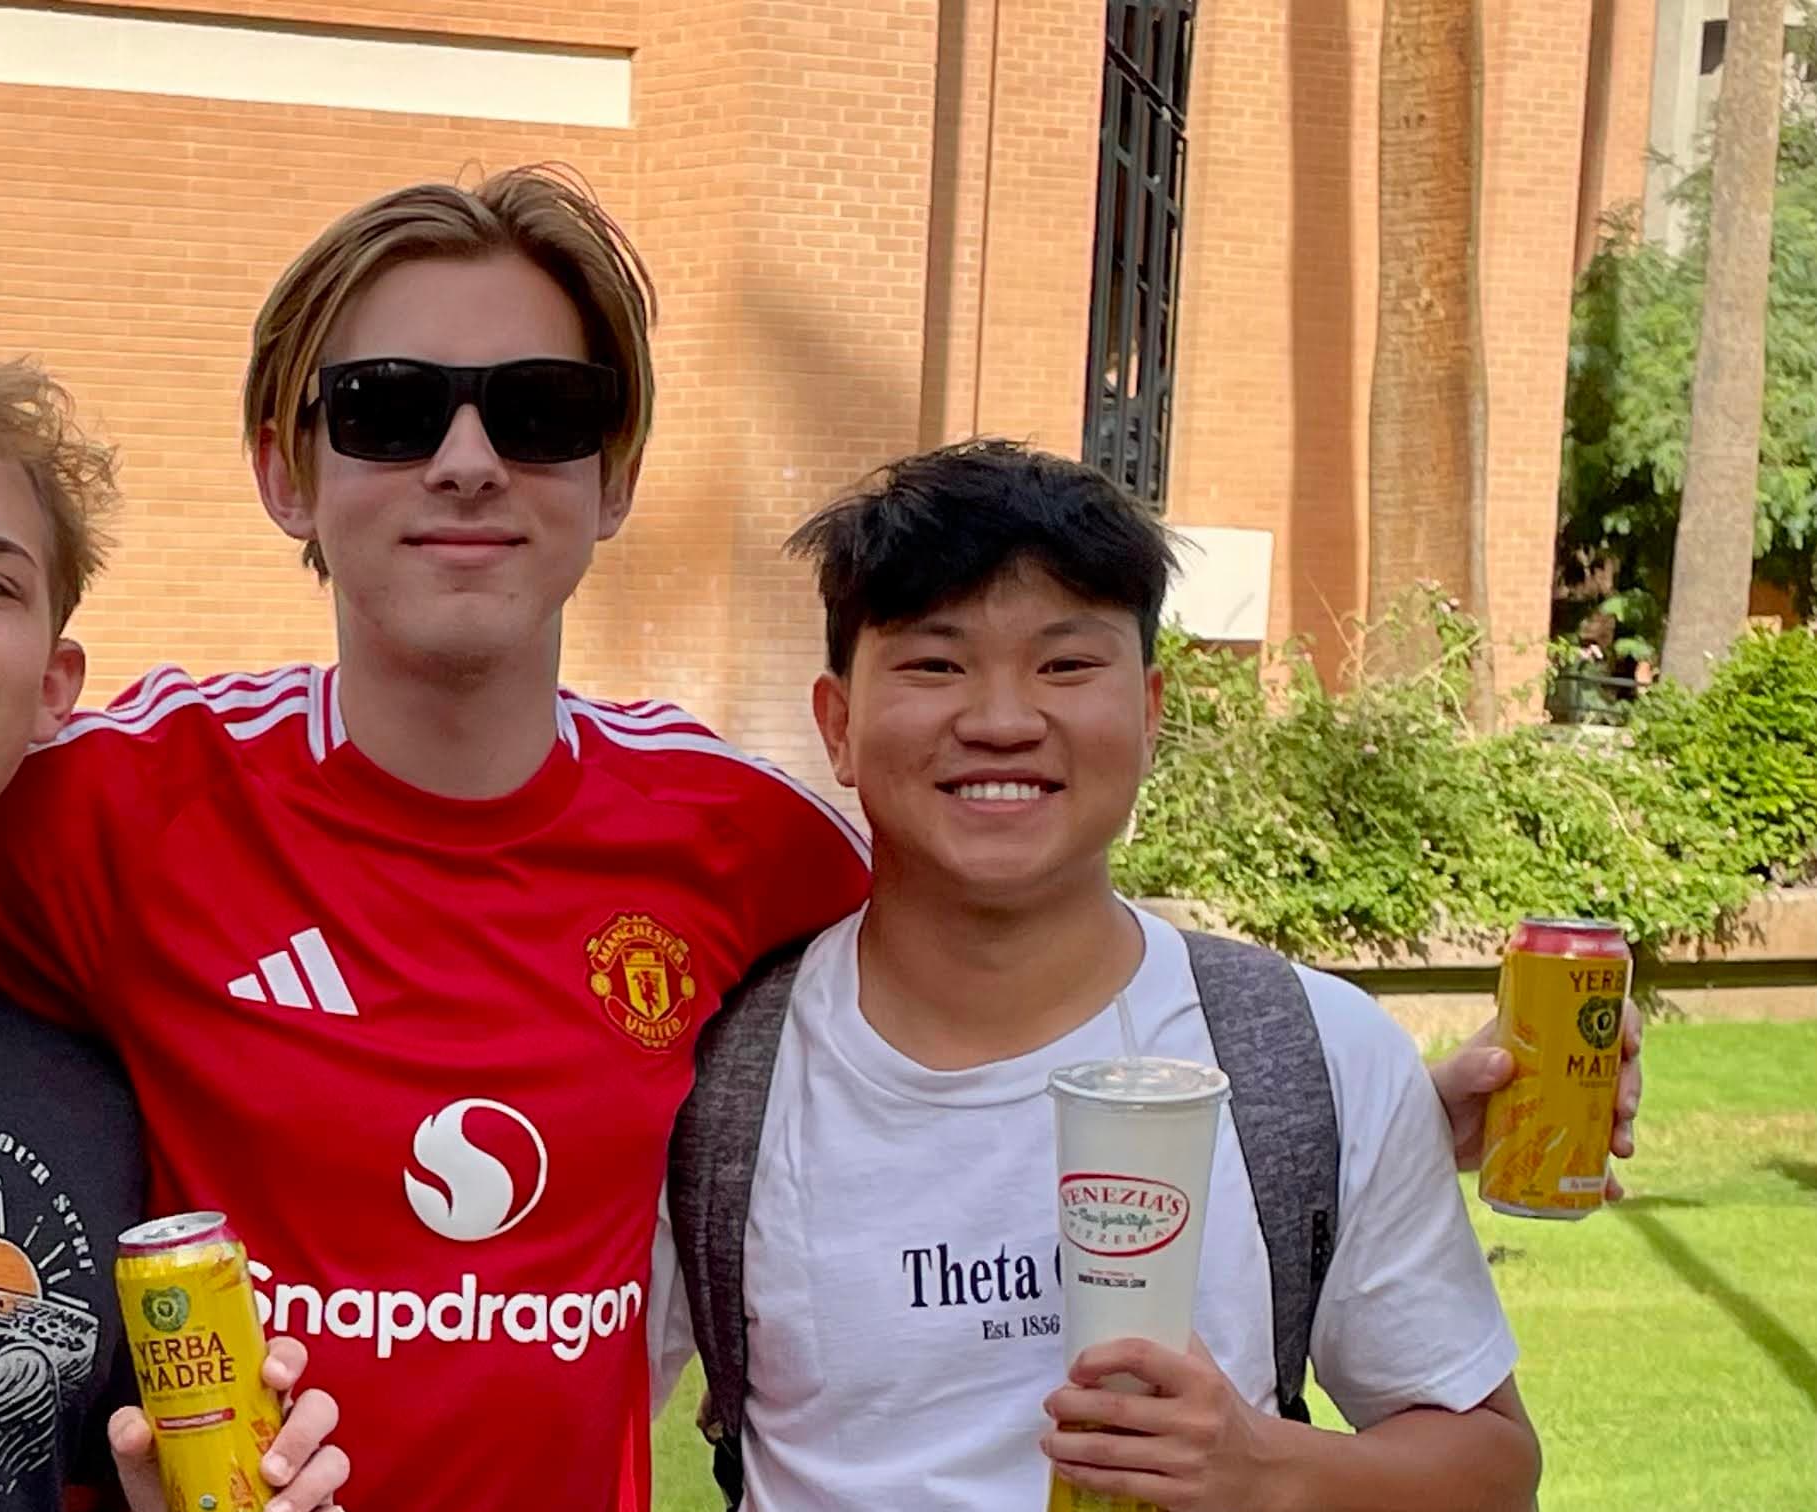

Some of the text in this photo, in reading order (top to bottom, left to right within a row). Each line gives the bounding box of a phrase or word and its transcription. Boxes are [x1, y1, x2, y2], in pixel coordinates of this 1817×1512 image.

[597, 924, 684, 965] MANCHESTER
[625, 1014, 682, 1039] UNITED
[1061, 1186, 1183, 1217] VENEZIA'S
[902, 1241, 1043, 1308] Theta
[982, 1314, 1061, 1340] Est. 1856
[134, 1330, 227, 1366] YERBA
[138, 1357, 236, 1394] MADRE
